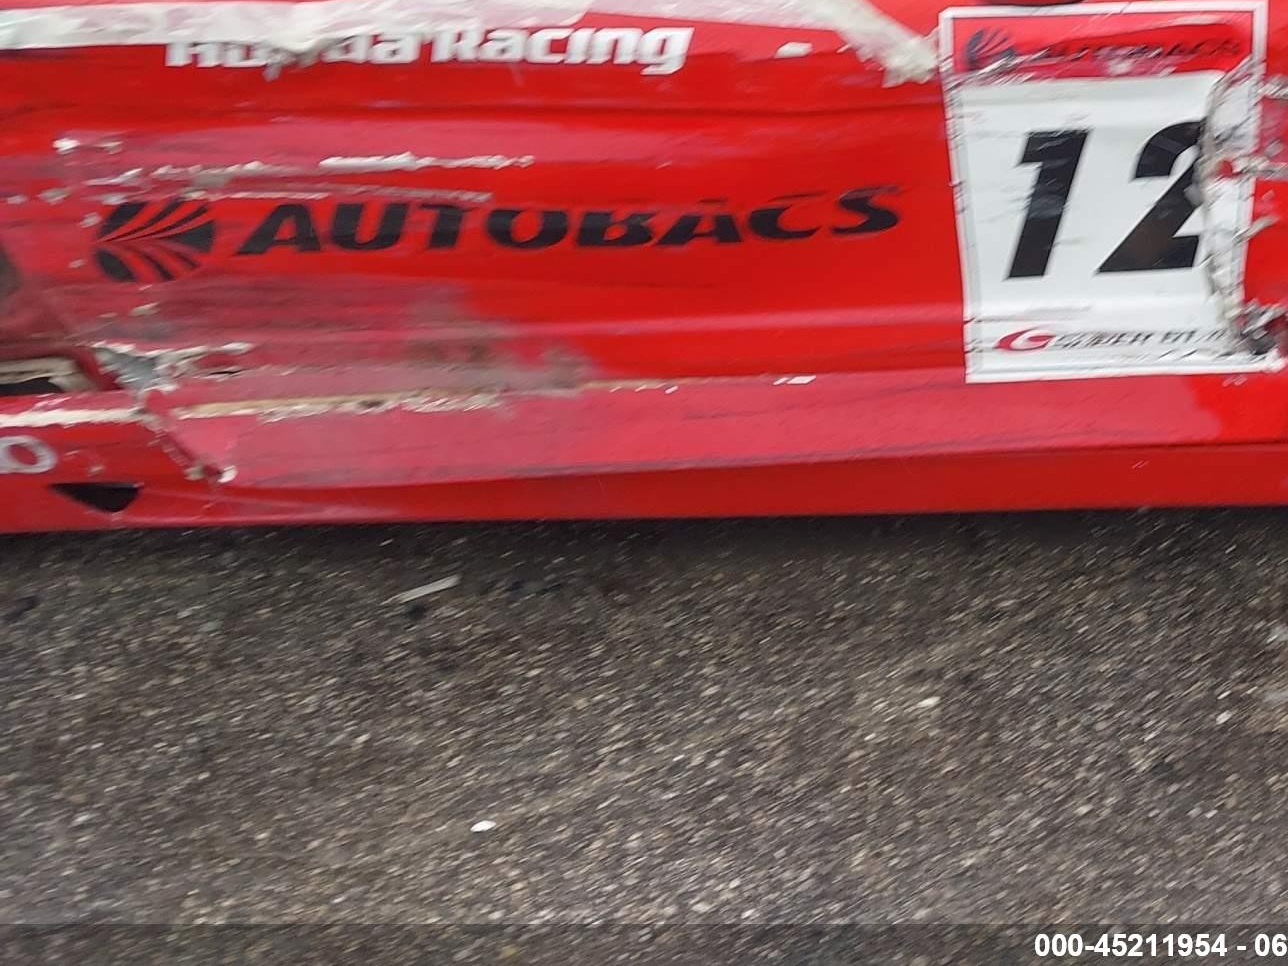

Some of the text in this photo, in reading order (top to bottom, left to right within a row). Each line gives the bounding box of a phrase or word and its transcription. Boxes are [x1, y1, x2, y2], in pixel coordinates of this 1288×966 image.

[430, 20, 694, 76] Racing
[235, 186, 902, 256] AUTOBACS
[1004, 120, 1206, 281] 12
